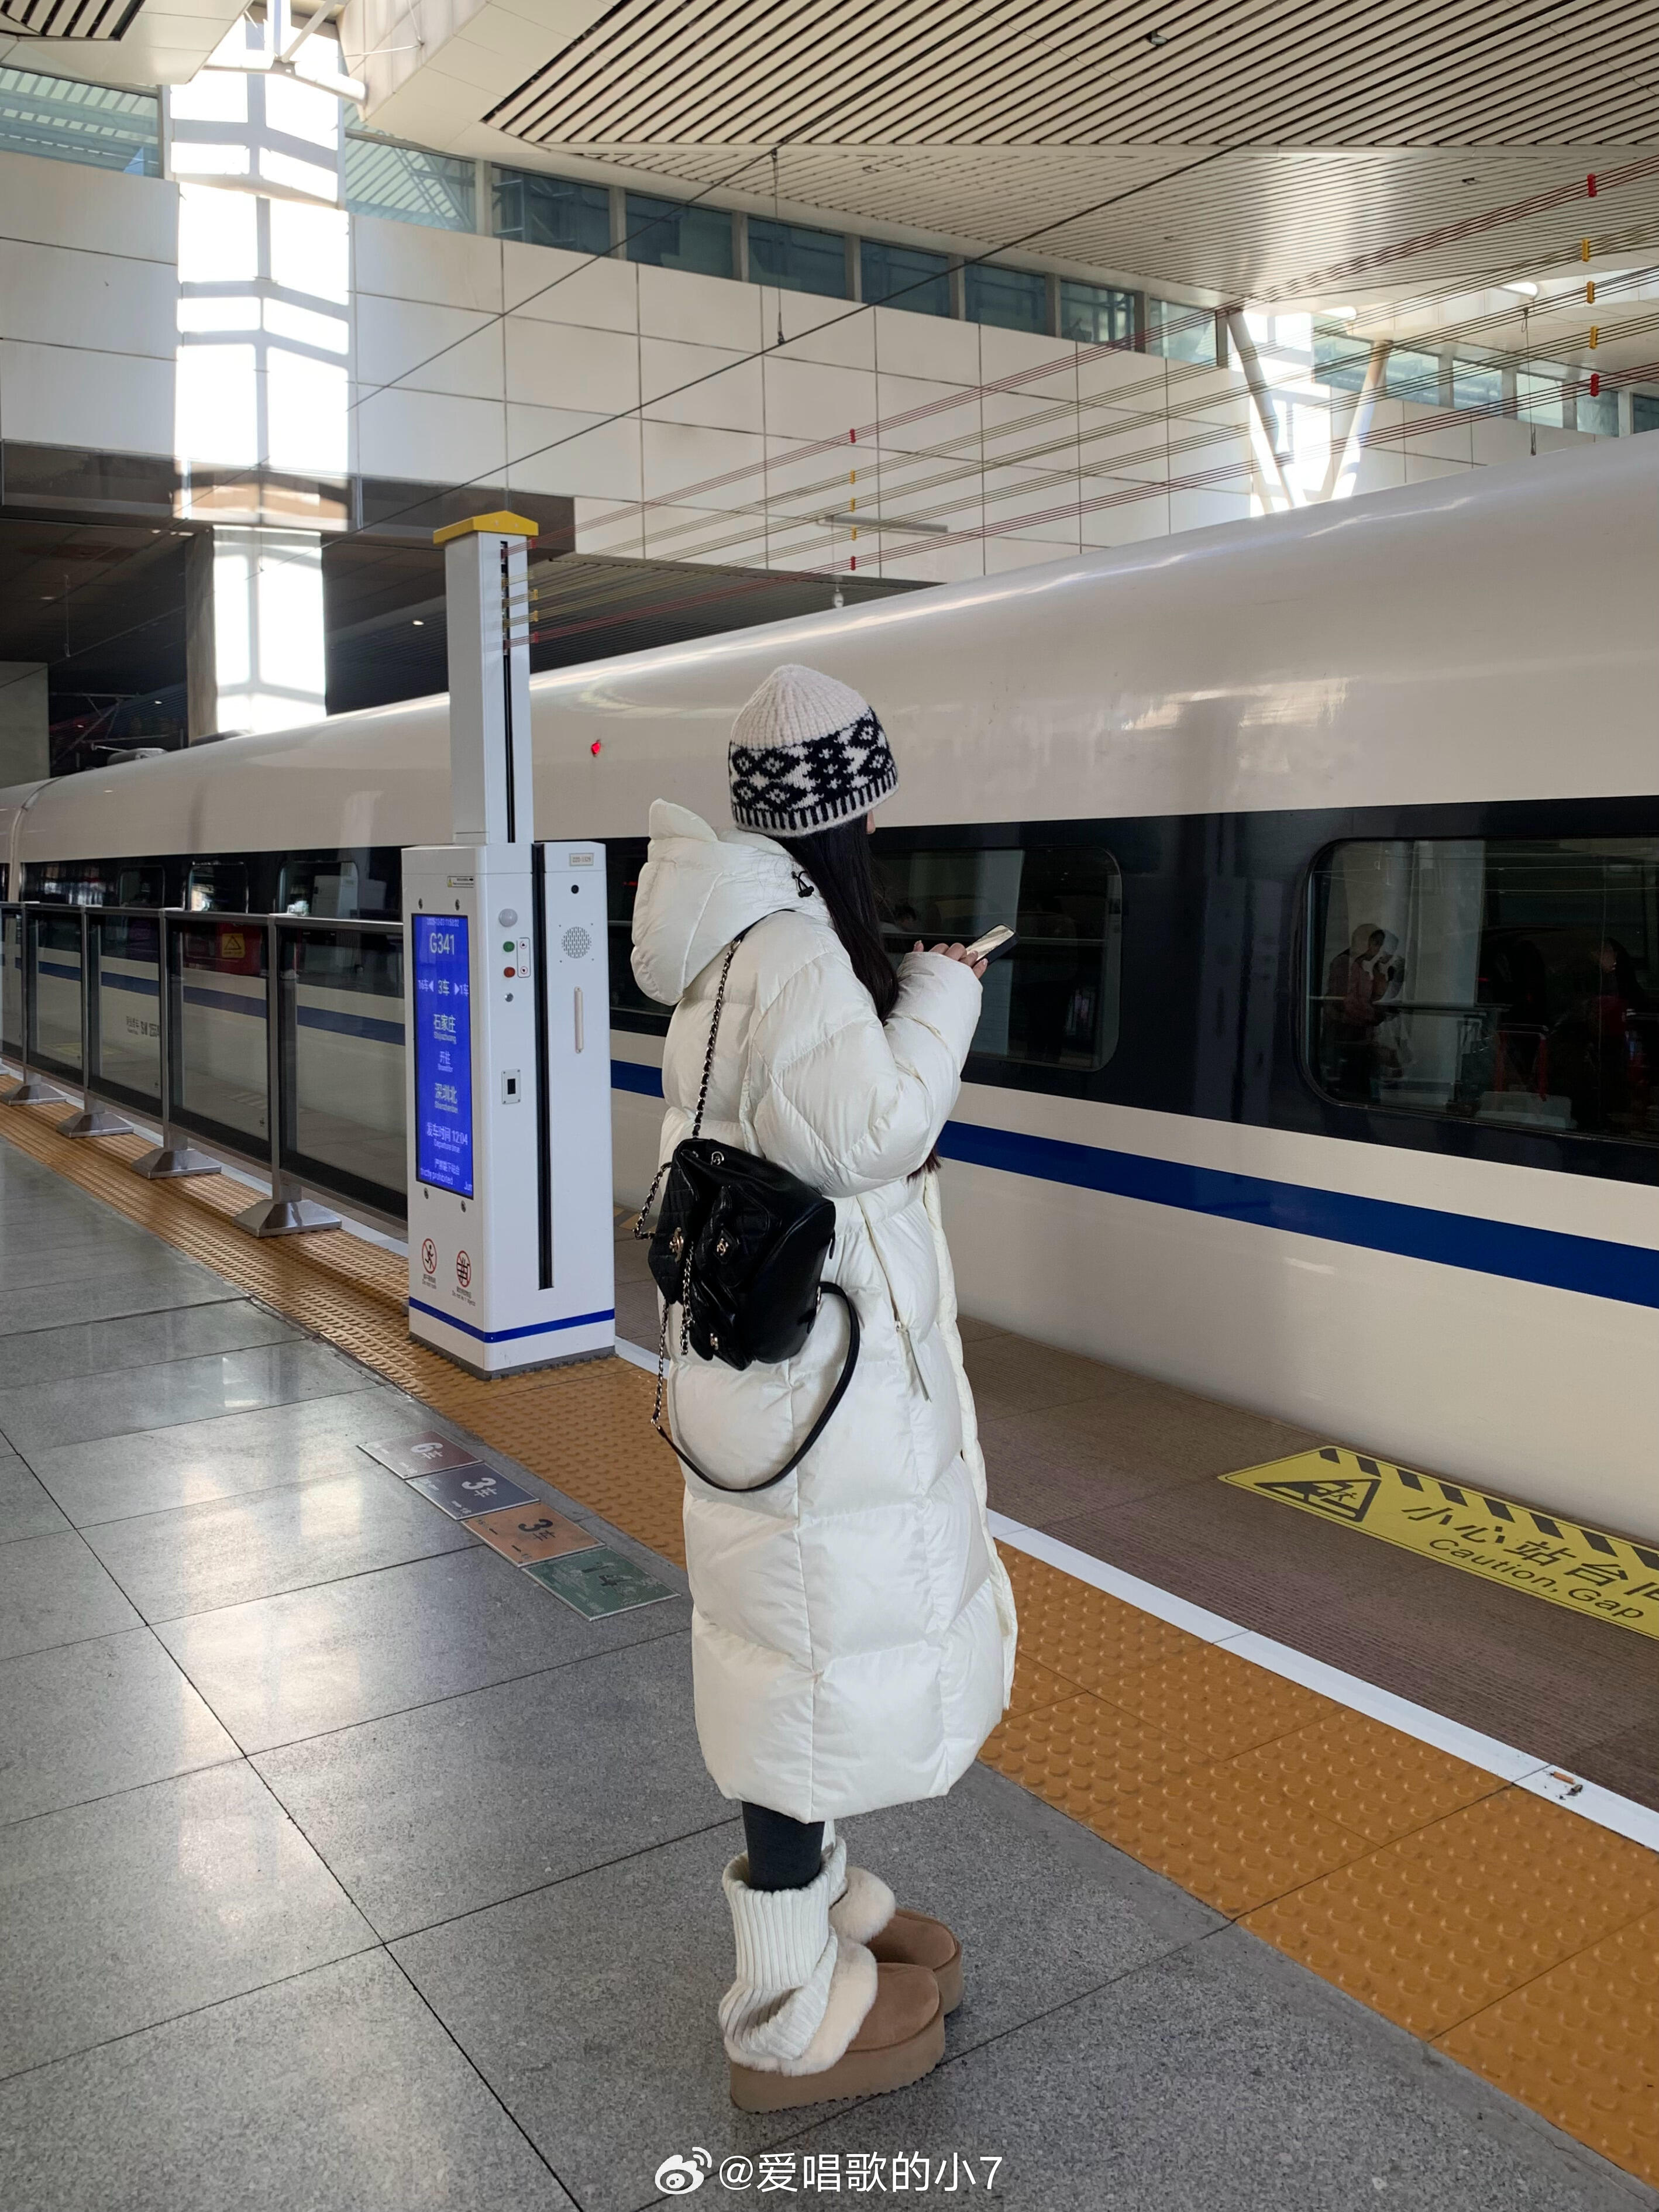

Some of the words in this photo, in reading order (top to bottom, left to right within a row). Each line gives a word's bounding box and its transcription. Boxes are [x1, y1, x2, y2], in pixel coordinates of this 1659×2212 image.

[430, 932, 455, 955] G341
[438, 979, 450, 996] 3车
[433, 1013, 456, 1033] 石家庄
[435, 1082, 457, 1105] 深圳北
[426, 1122, 451, 1143] 发车时间
[1429, 1539, 1559, 1593] Caution,
[1568, 1588, 1645, 1619] Gap
